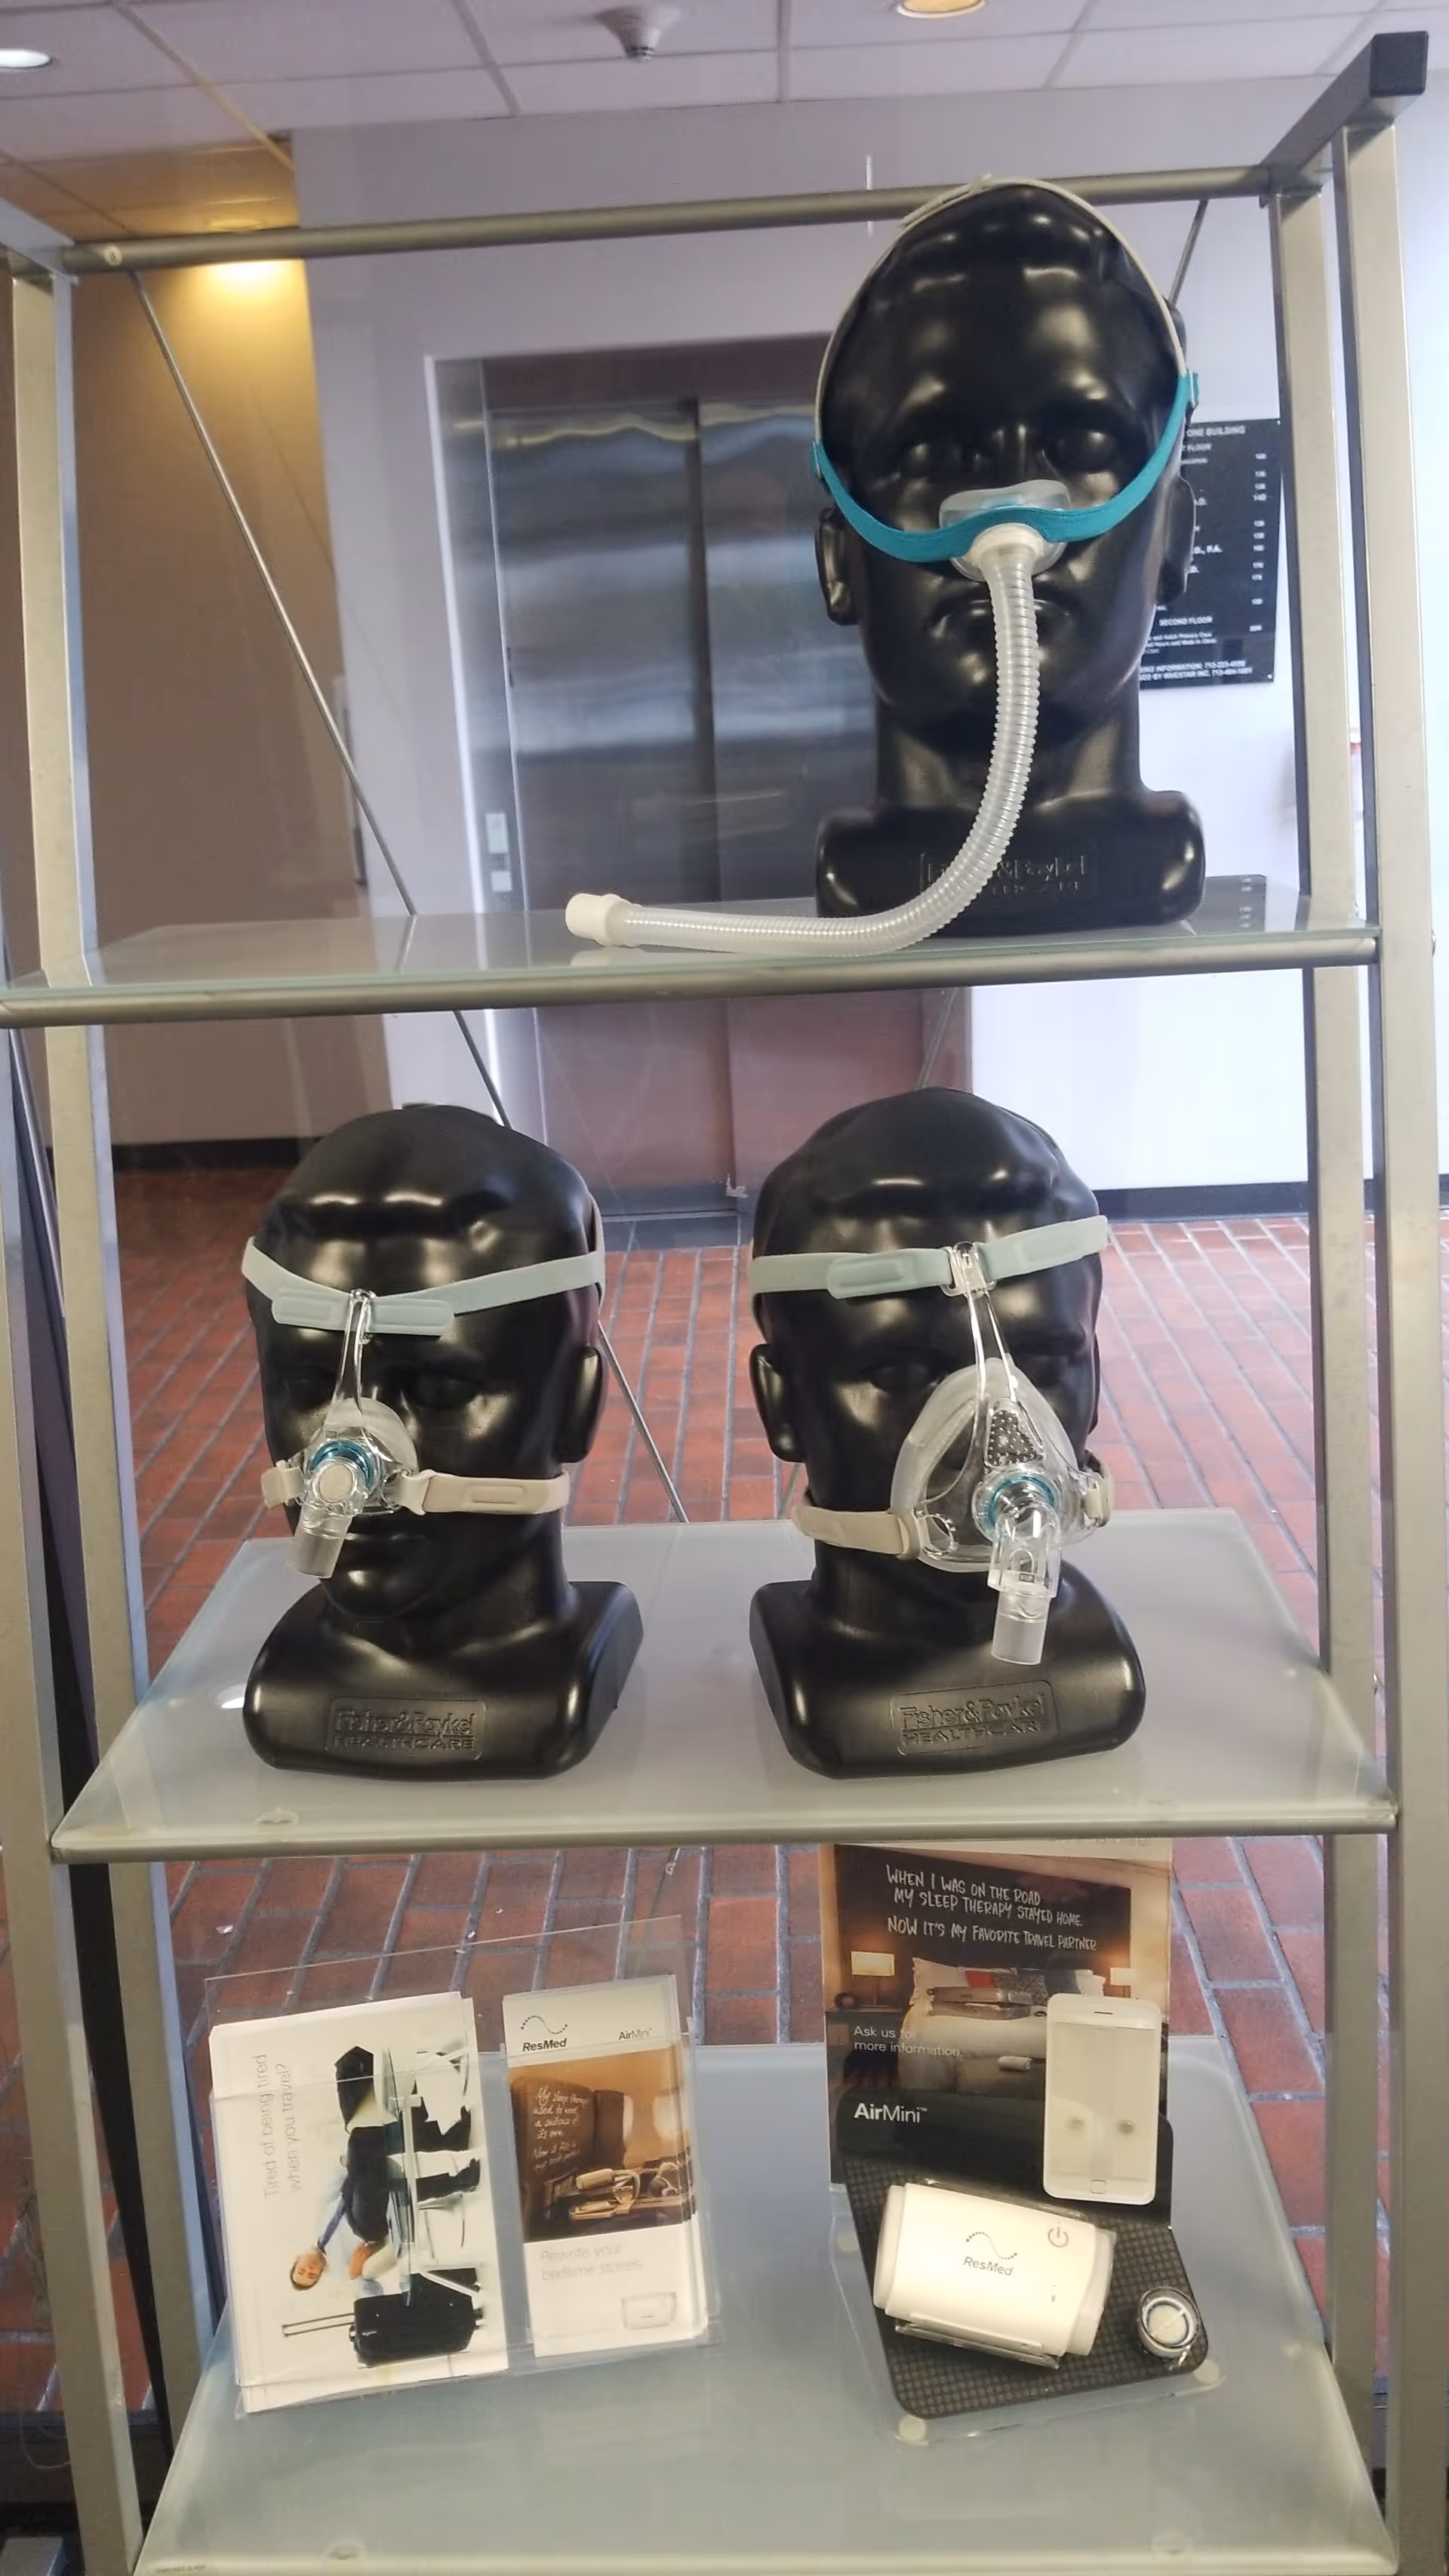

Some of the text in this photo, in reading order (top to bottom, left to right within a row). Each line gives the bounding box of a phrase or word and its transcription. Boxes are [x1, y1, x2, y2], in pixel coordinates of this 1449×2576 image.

[1186, 426, 1245, 437] ONE BUILDING
[1159, 616, 1213, 626] SECOND FLOOR
[886, 1864, 1041, 1906] WHEN I WAS ON THE ROAD
[894, 1887, 914, 1908] MY
[919, 1891, 958, 1912] SLEEP
[962, 1897, 1012, 1919] THERAPY
[1017, 1906, 1053, 1924] STAYED
[888, 1915, 918, 1935] NOW
[924, 1921, 946, 1937] IT'S
[951, 1922, 967, 1942] MY
[973, 1925, 1020, 1944] FAVORITE
[1023, 1931, 1056, 1947] TRAVEL
[854, 2026, 877, 2037] Ask
[881, 2030, 896, 2038] us
[522, 2038, 568, 2052] ResMed
[854, 2042, 887, 2051] more
[251, 2054, 278, 2198] Tired of being tired
[275, 2064, 301, 2193] when you travel?
[593, 2244, 622, 2258] your
[964, 2256, 1014, 2276] ResMed
